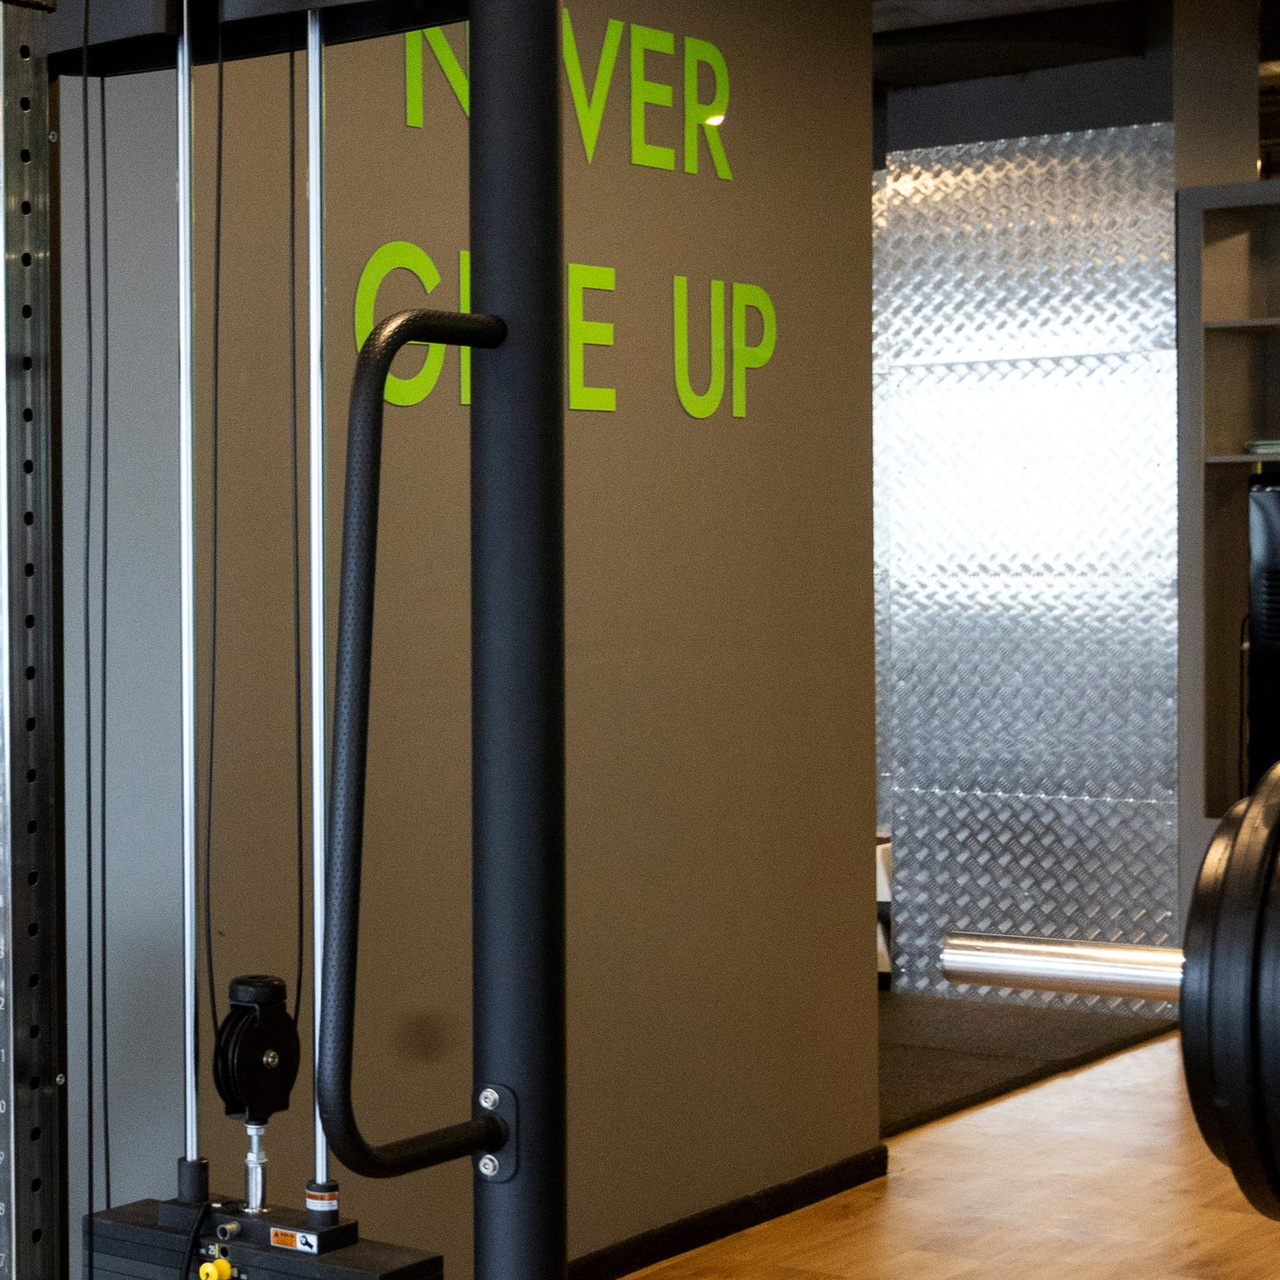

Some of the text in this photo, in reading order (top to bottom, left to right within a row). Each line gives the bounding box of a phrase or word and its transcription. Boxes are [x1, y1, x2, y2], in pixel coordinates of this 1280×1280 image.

[405, 8, 733, 180] NVER
[354, 241, 777, 419] GIE UP
